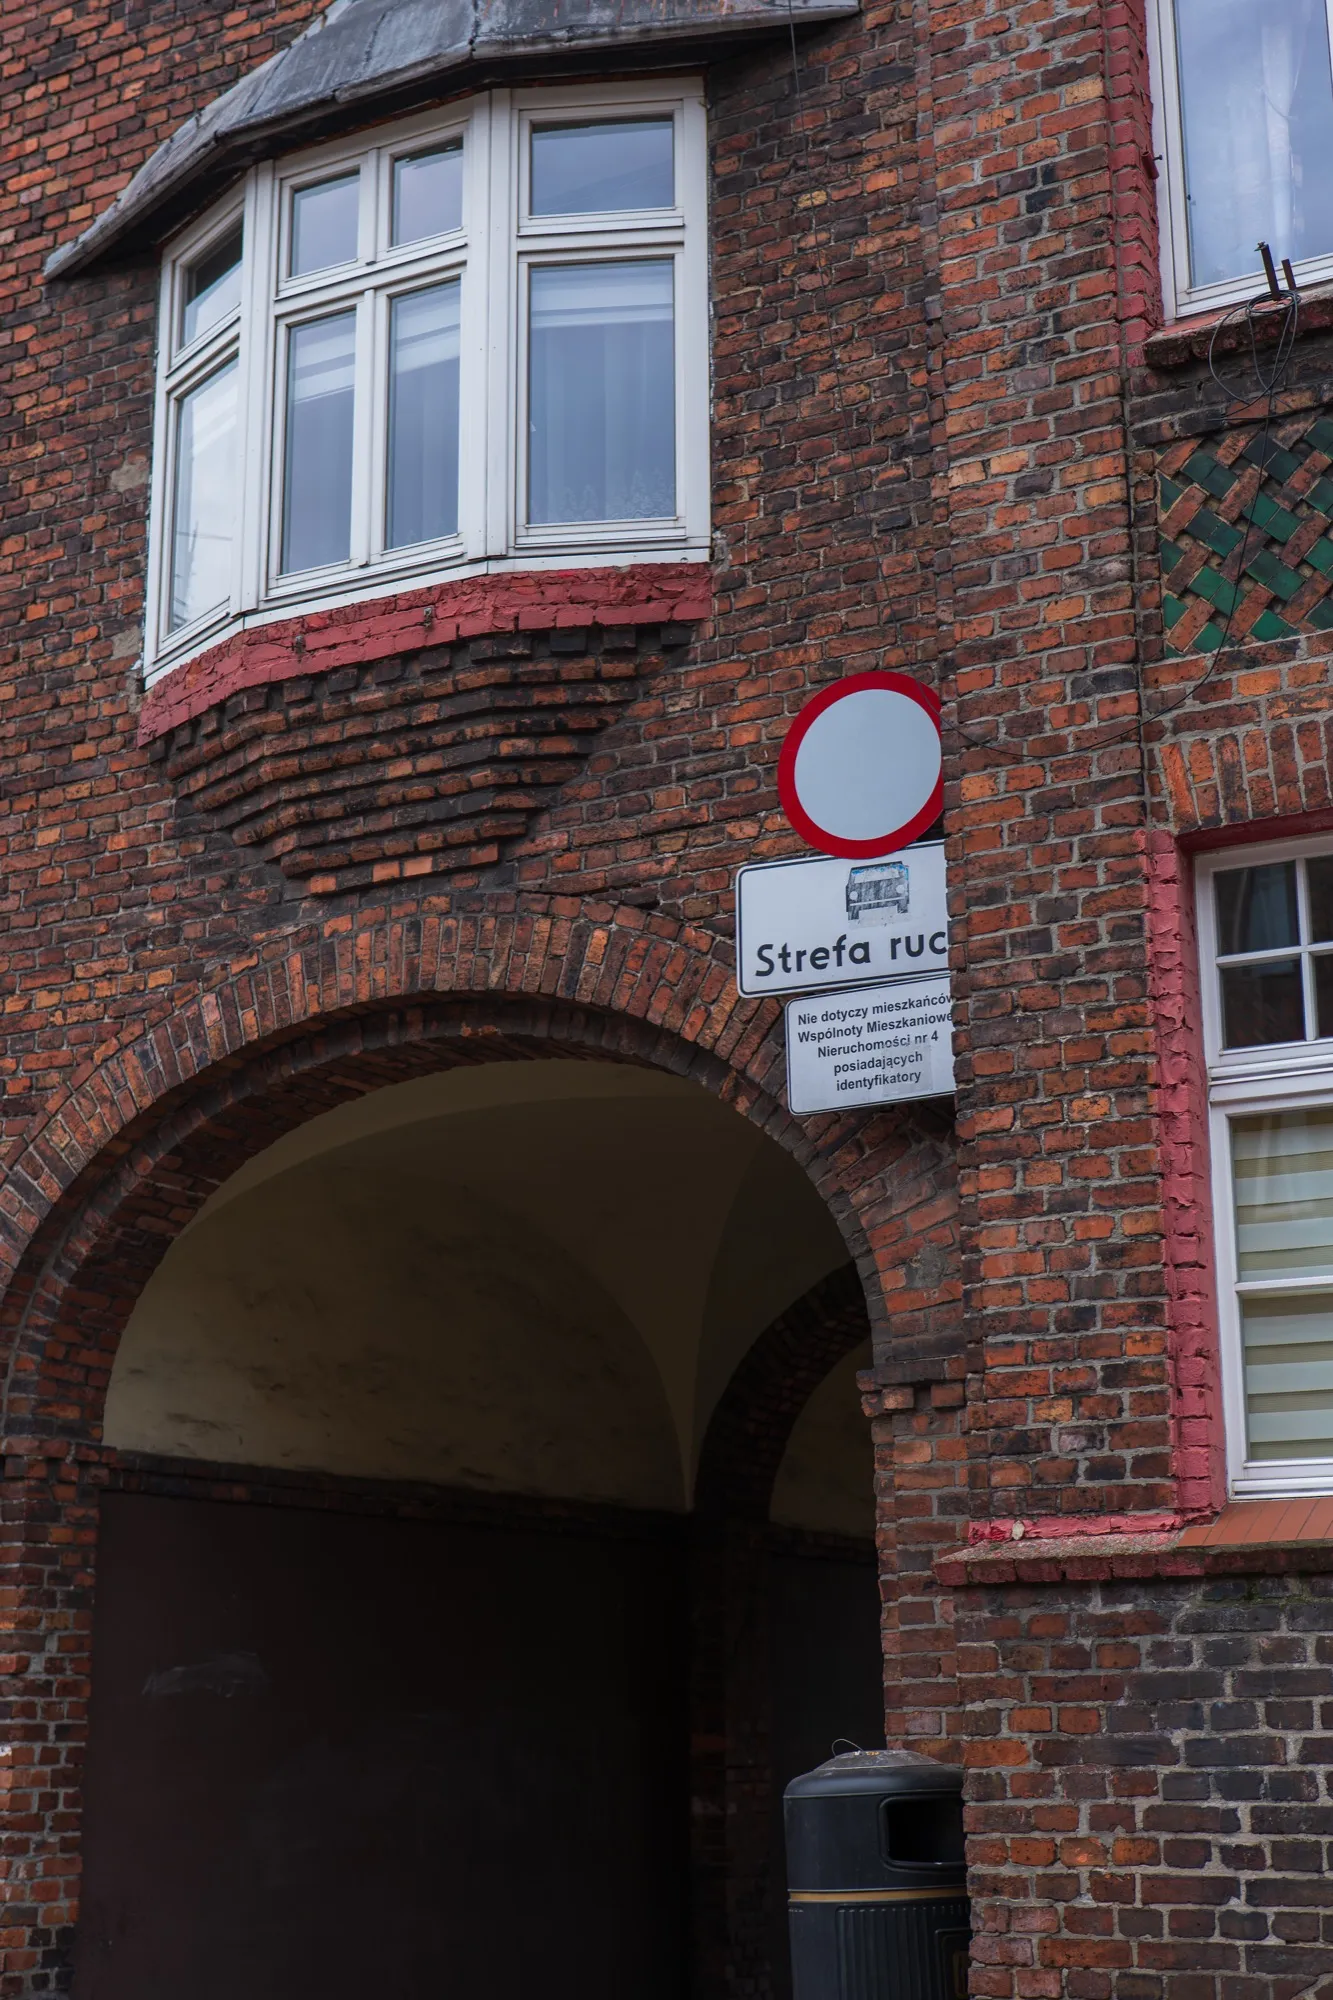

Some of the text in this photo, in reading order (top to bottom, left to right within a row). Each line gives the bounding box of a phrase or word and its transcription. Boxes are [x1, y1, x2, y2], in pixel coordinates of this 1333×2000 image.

[755, 934, 871, 977] Strefa
[797, 1013, 818, 1026] Nie
[820, 1006, 869, 1022] dotyczy
[797, 1023, 864, 1043] Wspólnoty
[817, 1030, 939, 1058] Nieruchomości nr 4
[833, 1051, 923, 1077] posiadających
[836, 1070, 922, 1092] identyfikatory
